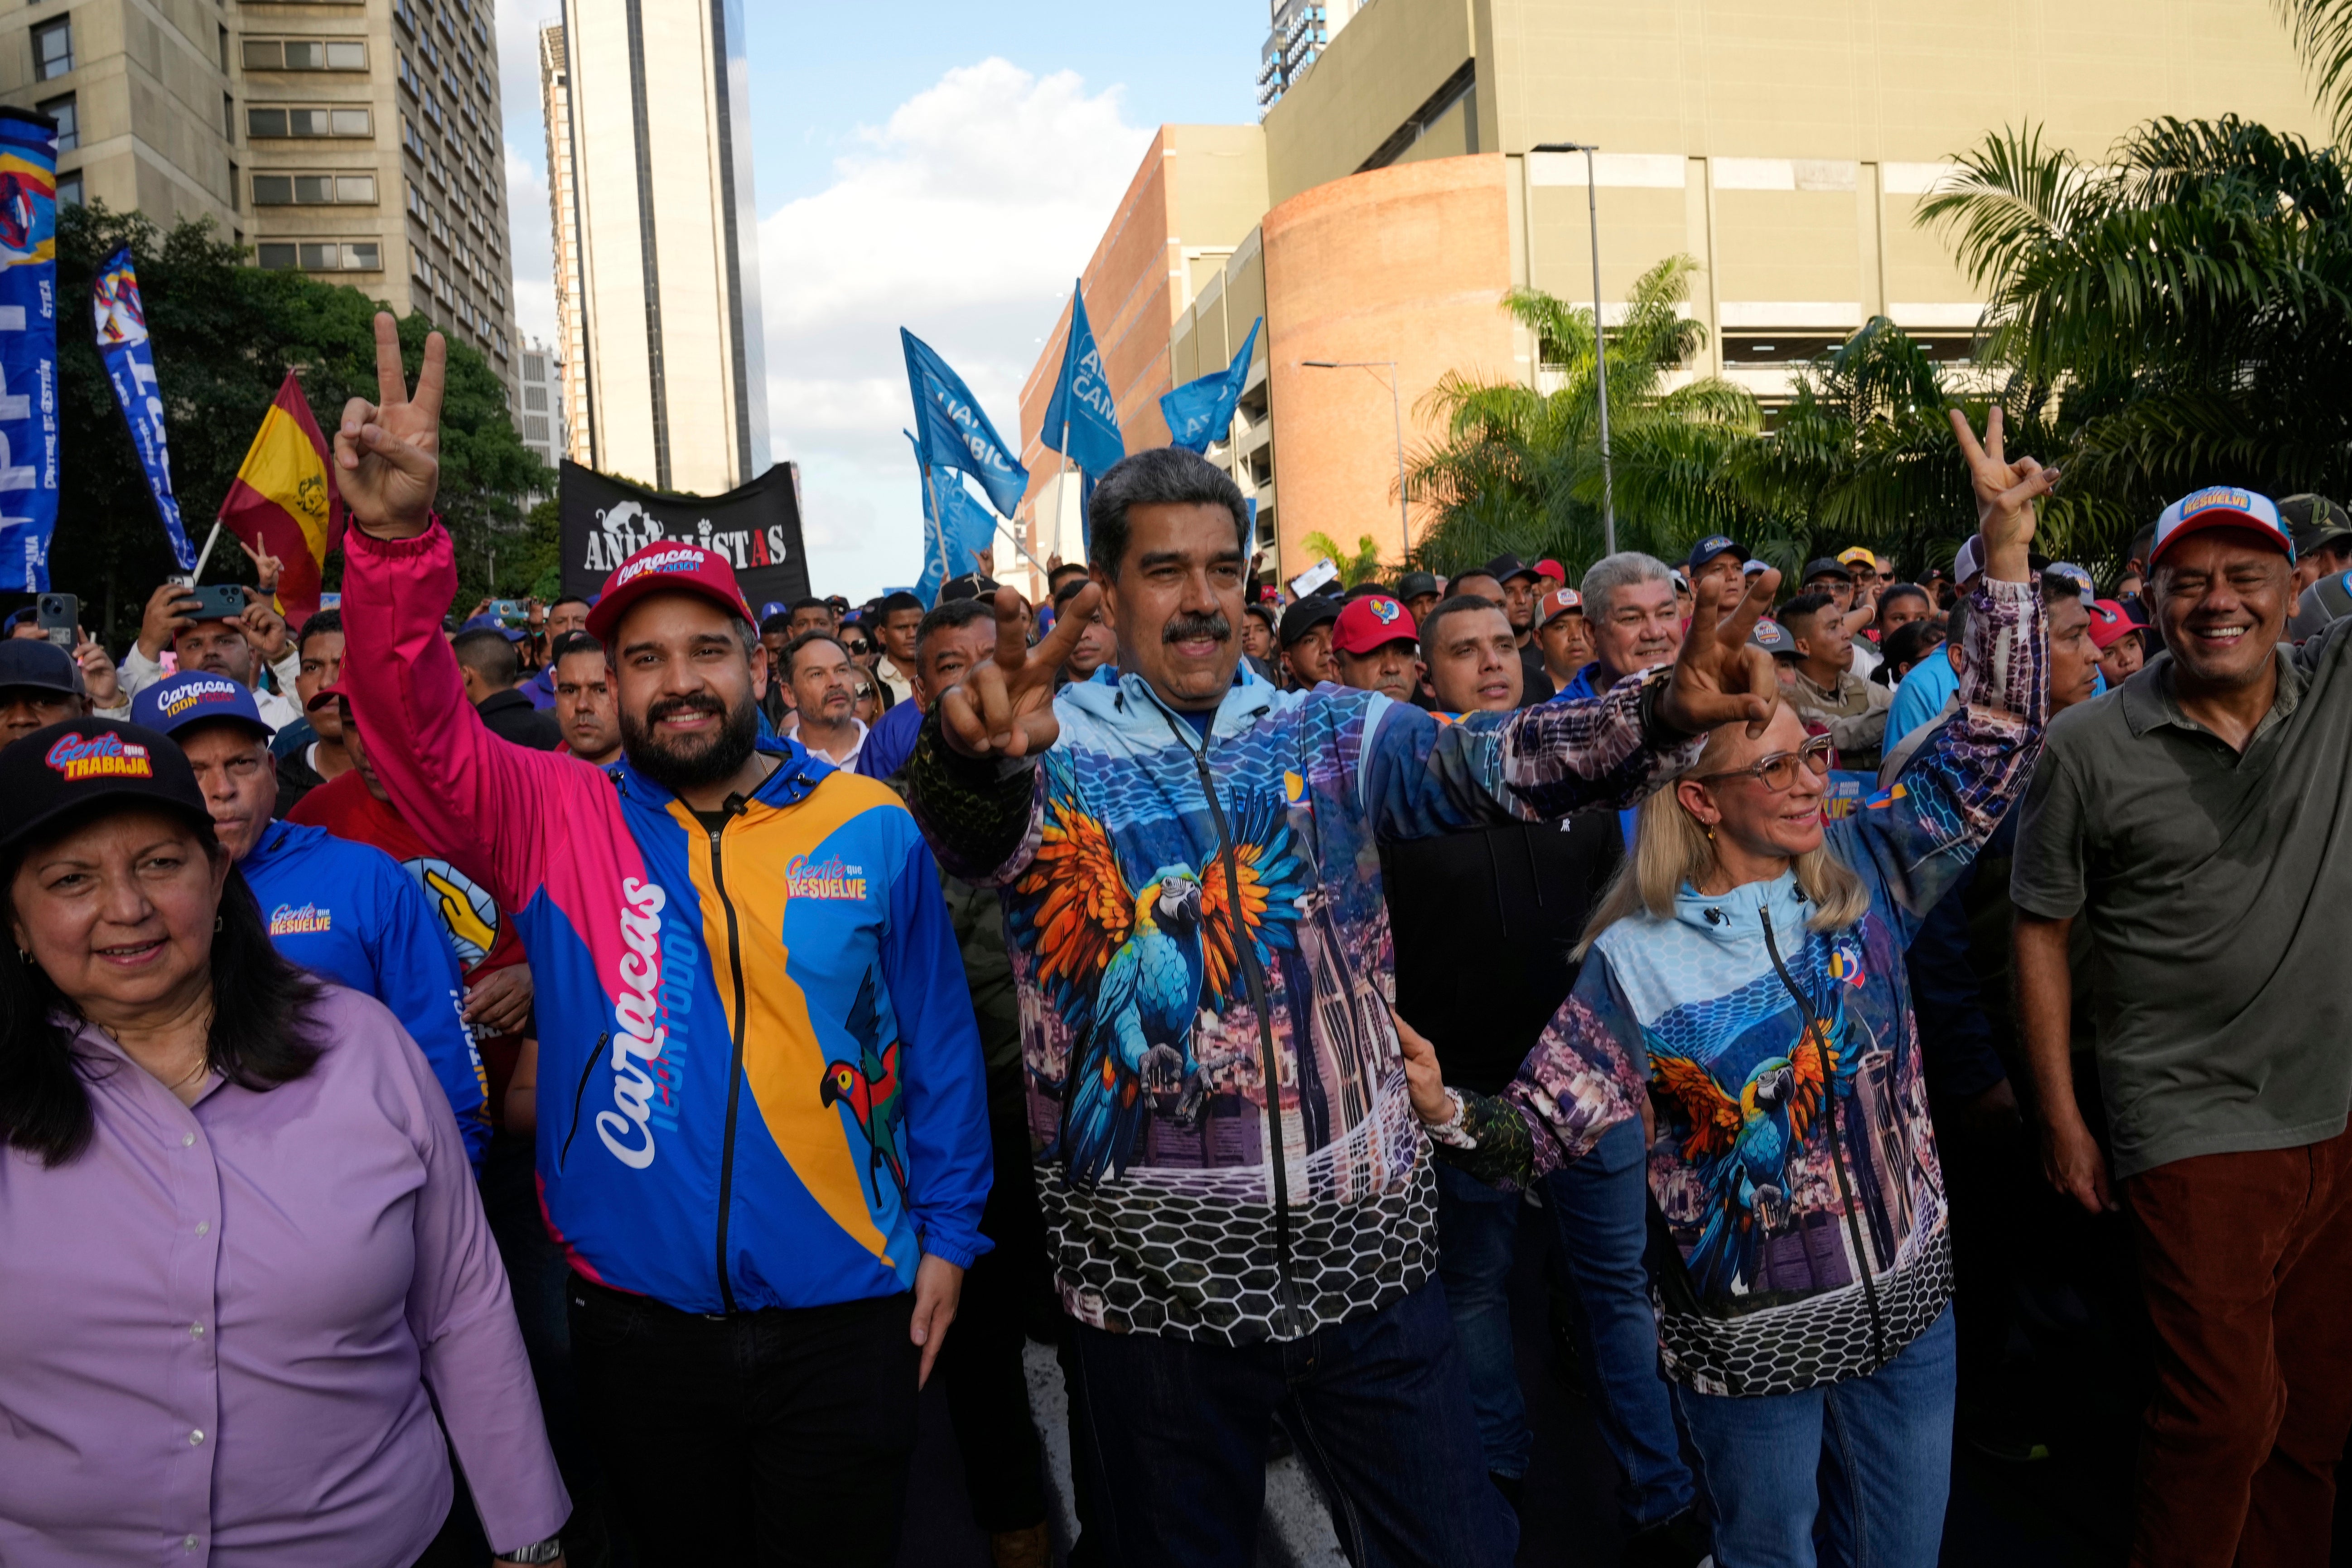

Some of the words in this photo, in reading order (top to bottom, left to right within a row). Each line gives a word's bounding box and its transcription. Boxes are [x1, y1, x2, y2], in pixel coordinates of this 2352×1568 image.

[2183, 495, 2249, 517] RESUELVE
[617, 549, 705, 587] Caracas
[157, 680, 236, 711] Caracas
[50, 733, 122, 769] Gente
[124, 744, 145, 756] que
[66, 755, 150, 778] TRABAJA
[784, 853, 846, 884] Gente
[846, 864, 863, 876] que
[786, 877, 867, 900] RESUELVE
[270, 916, 331, 936] RESUELVE
[271, 901, 316, 926] Gente
[317, 908, 330, 917] que
[595, 876, 666, 1169] Caracas
